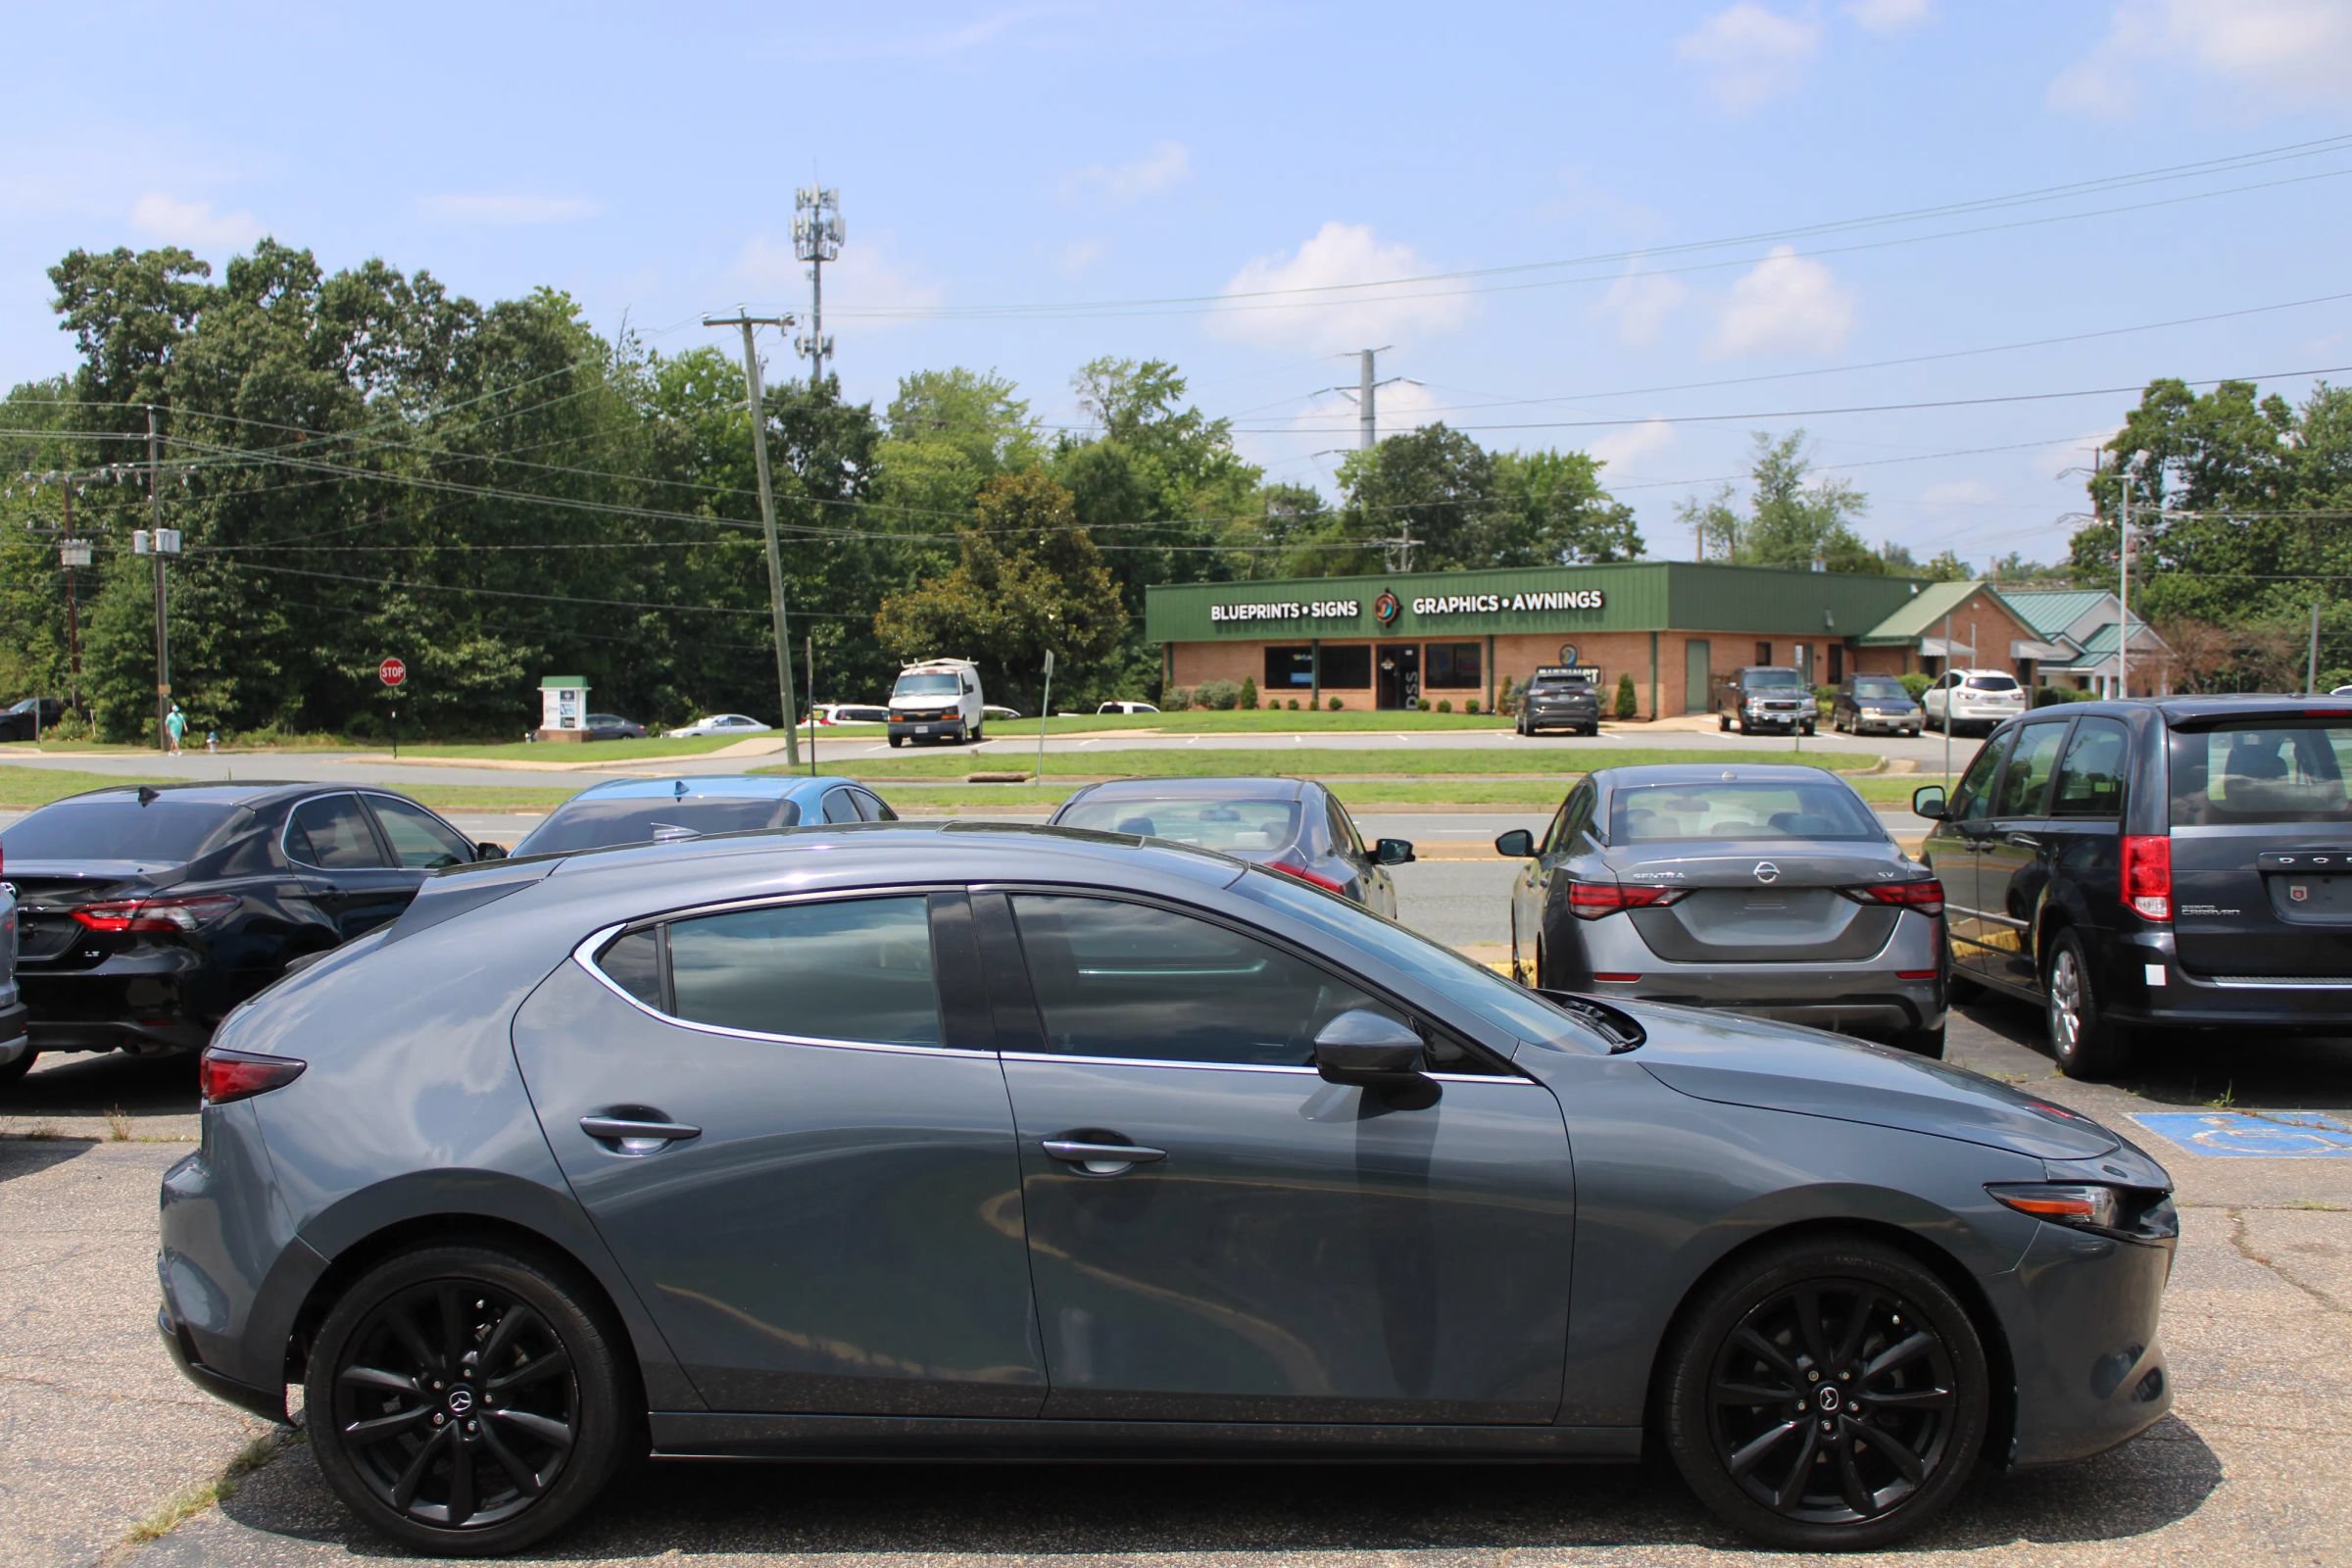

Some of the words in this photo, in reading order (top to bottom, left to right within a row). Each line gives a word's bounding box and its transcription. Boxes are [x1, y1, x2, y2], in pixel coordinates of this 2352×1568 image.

[1211, 603, 1299, 620] BLUEPRINTS
[1310, 601, 1358, 617] SIGNS
[1412, 594, 1499, 614] GRAPHICS
[1512, 590, 1602, 611] AWNINGS
[382, 666, 404, 677] STOP
